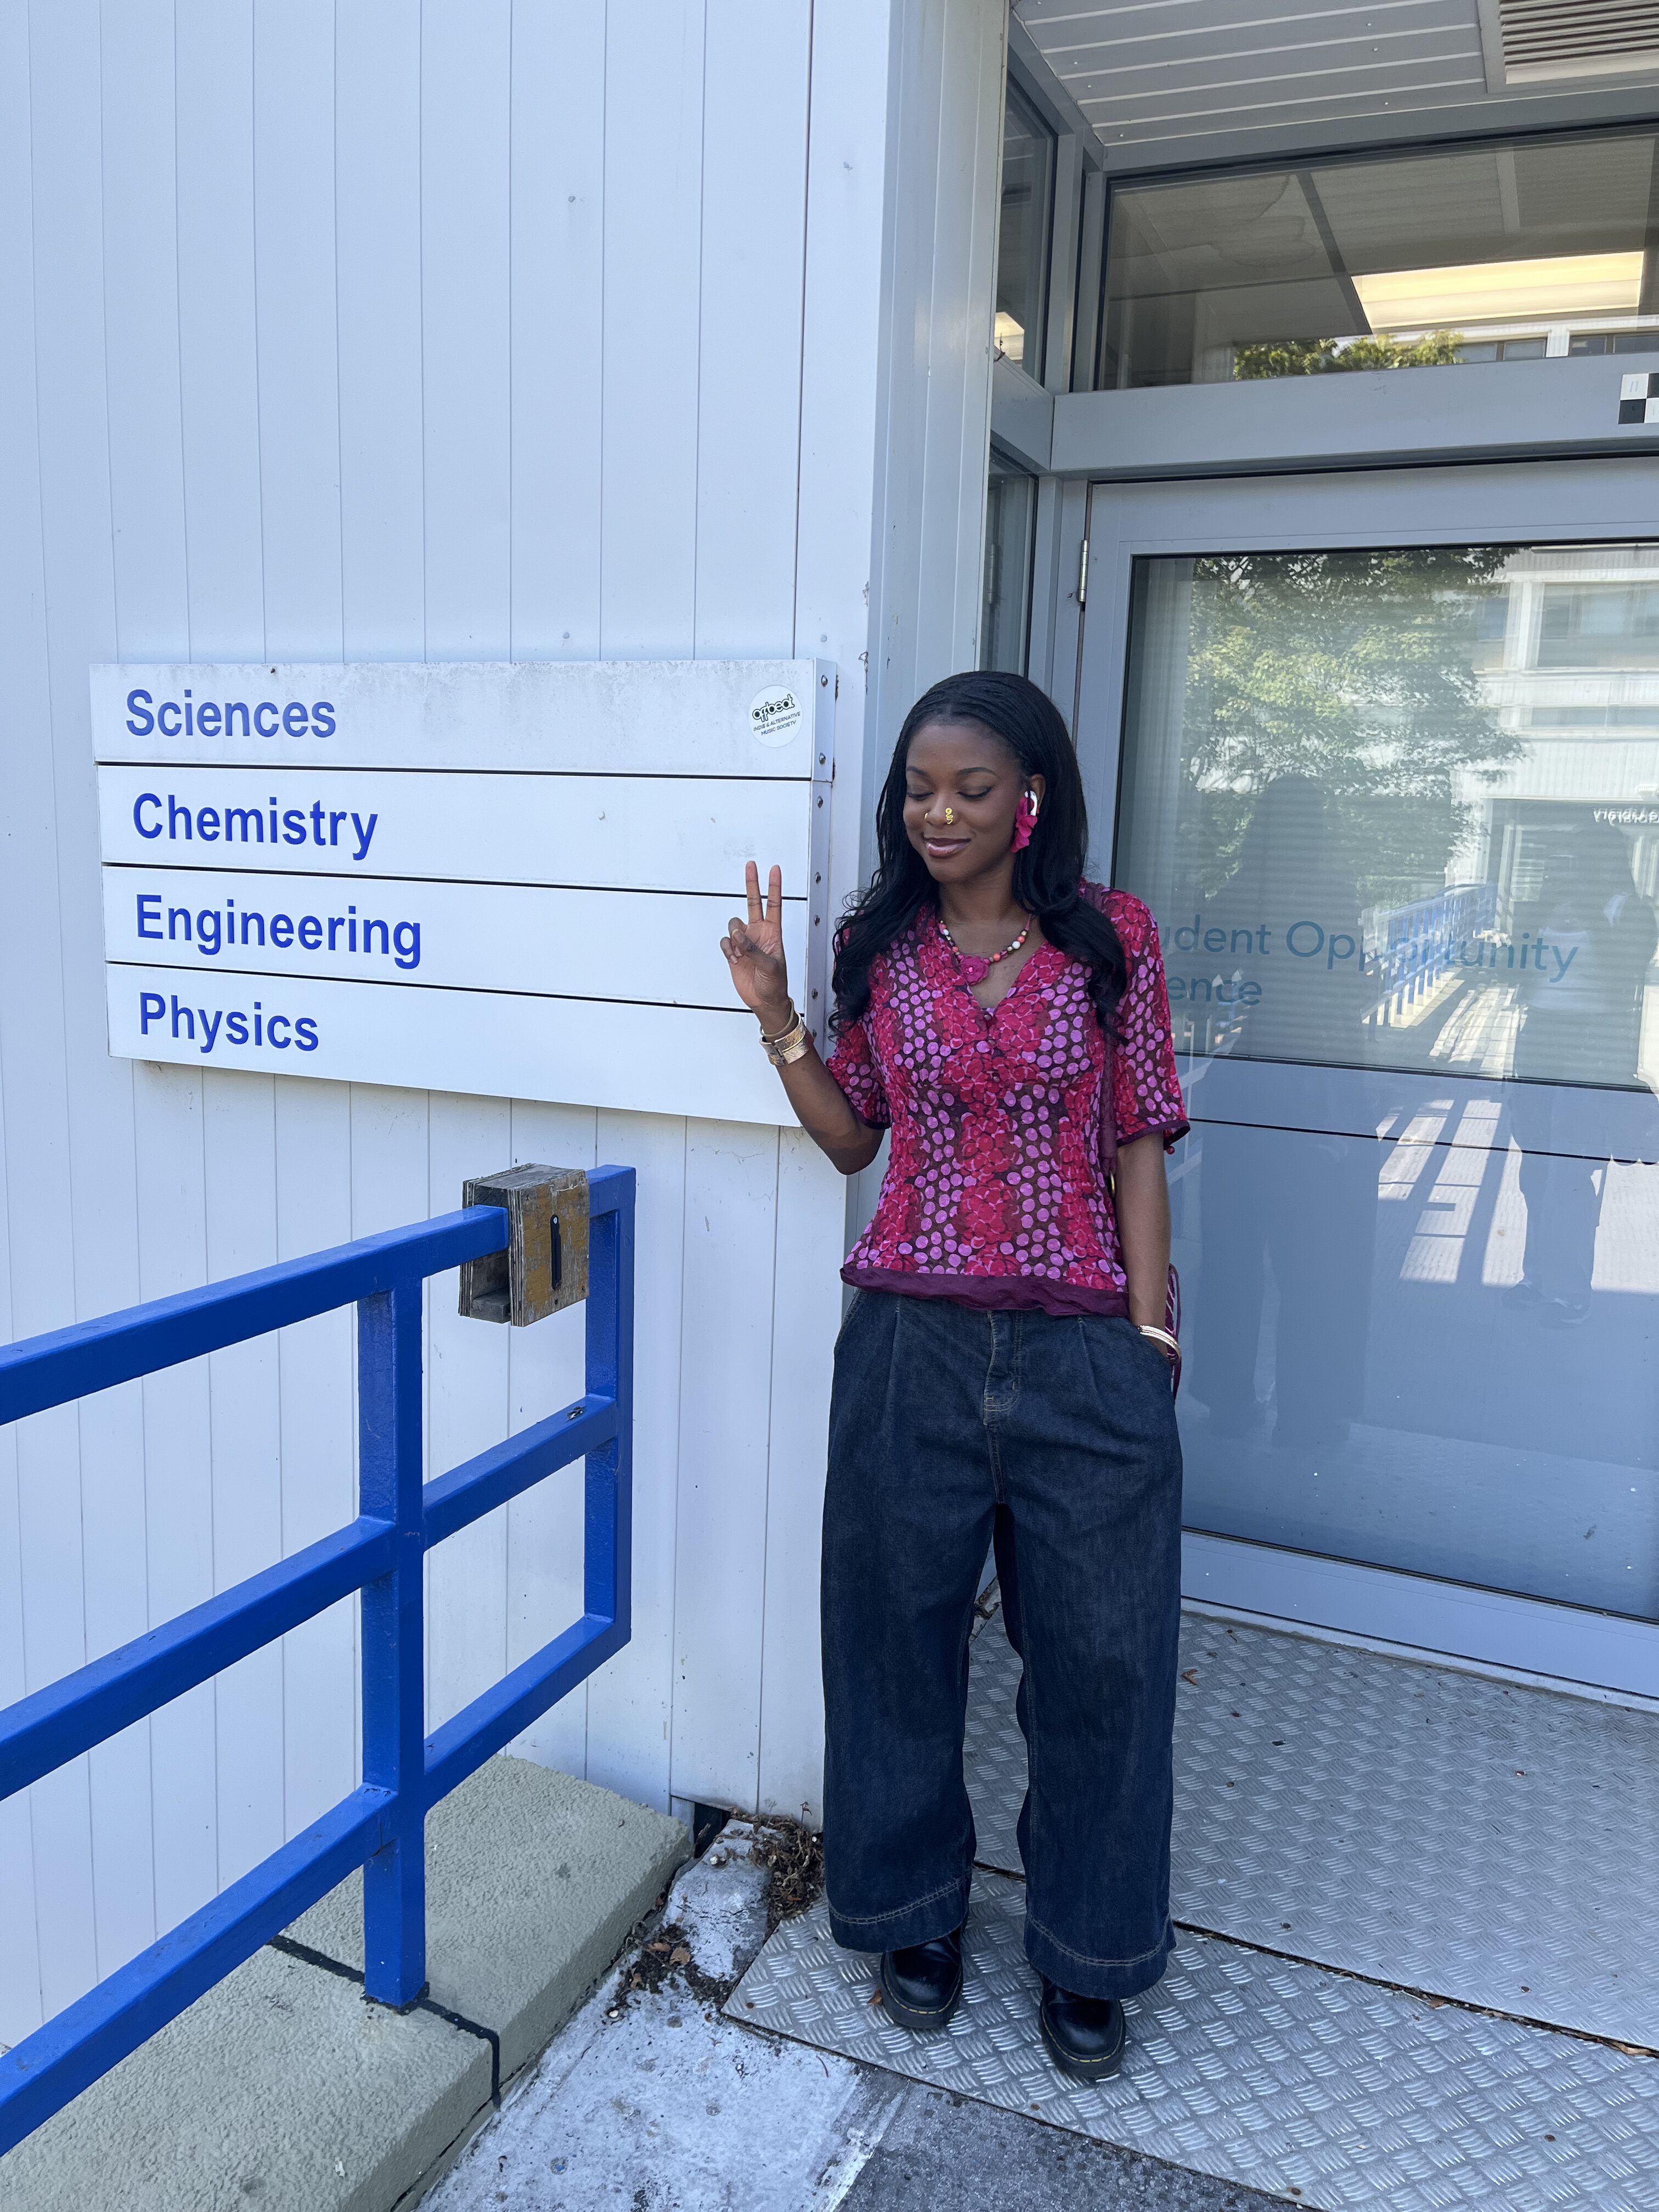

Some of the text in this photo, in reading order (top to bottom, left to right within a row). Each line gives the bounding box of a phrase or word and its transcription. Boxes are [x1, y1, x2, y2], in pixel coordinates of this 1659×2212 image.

[126, 689, 336, 738] Sciences
[753, 723, 766, 732] INDIE
[770, 711, 801, 726] ALTERNATIVE
[761, 720, 797, 736] MUSIC SOCIETY
[133, 792, 379, 861] Chemistry
[136, 894, 421, 969] Engineering
[139, 992, 319, 1053] Physics
